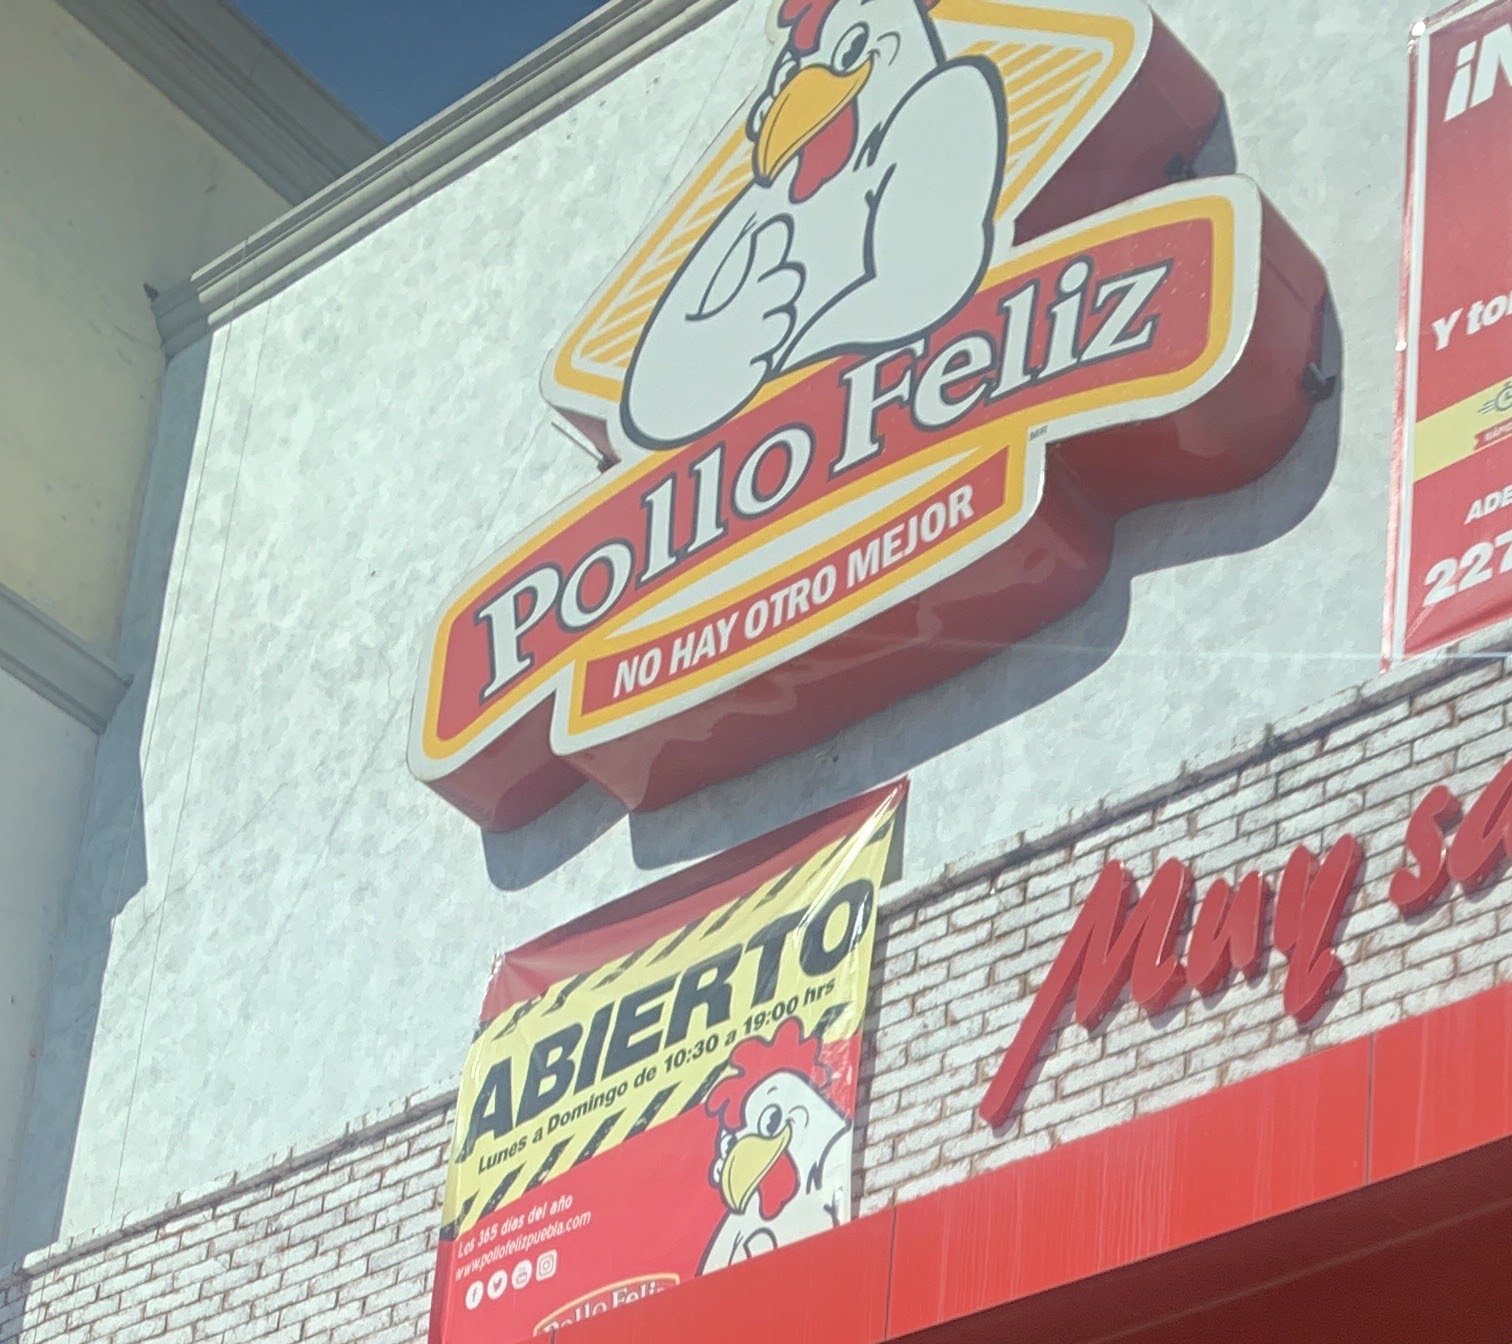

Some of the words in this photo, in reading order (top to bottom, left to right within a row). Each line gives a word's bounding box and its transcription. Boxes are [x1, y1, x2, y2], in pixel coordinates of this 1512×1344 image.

[1432, 308, 1463, 351] Y
[474, 421, 816, 706] Pollo
[827, 255, 1175, 481] Feliz
[611, 654, 663, 701] NO
[668, 613, 735, 678] HAY
[744, 568, 838, 640] OTRO
[846, 484, 977, 590] MEJOR
[455, 878, 876, 1163] ABIERTO
[478, 1135, 528, 1174] Lunes
[531, 1128, 543, 1144] a
[547, 1079, 628, 1135] Domingo
[633, 1067, 657, 1090] de
[665, 1034, 720, 1073] 10:30
[724, 1028, 737, 1047] a
[743, 996, 799, 1036] 19:00
[802, 977, 836, 1006] hrs
[979, 834, 1364, 1130] Muy
[455, 1210, 592, 1282] www.pollofelizpuebla.com
[457, 1237, 475, 1259] Los
[478, 1224, 497, 1249] 365
[501, 1213, 525, 1237] días
[527, 1205, 547, 1226] del
[550, 1194, 573, 1215] año
